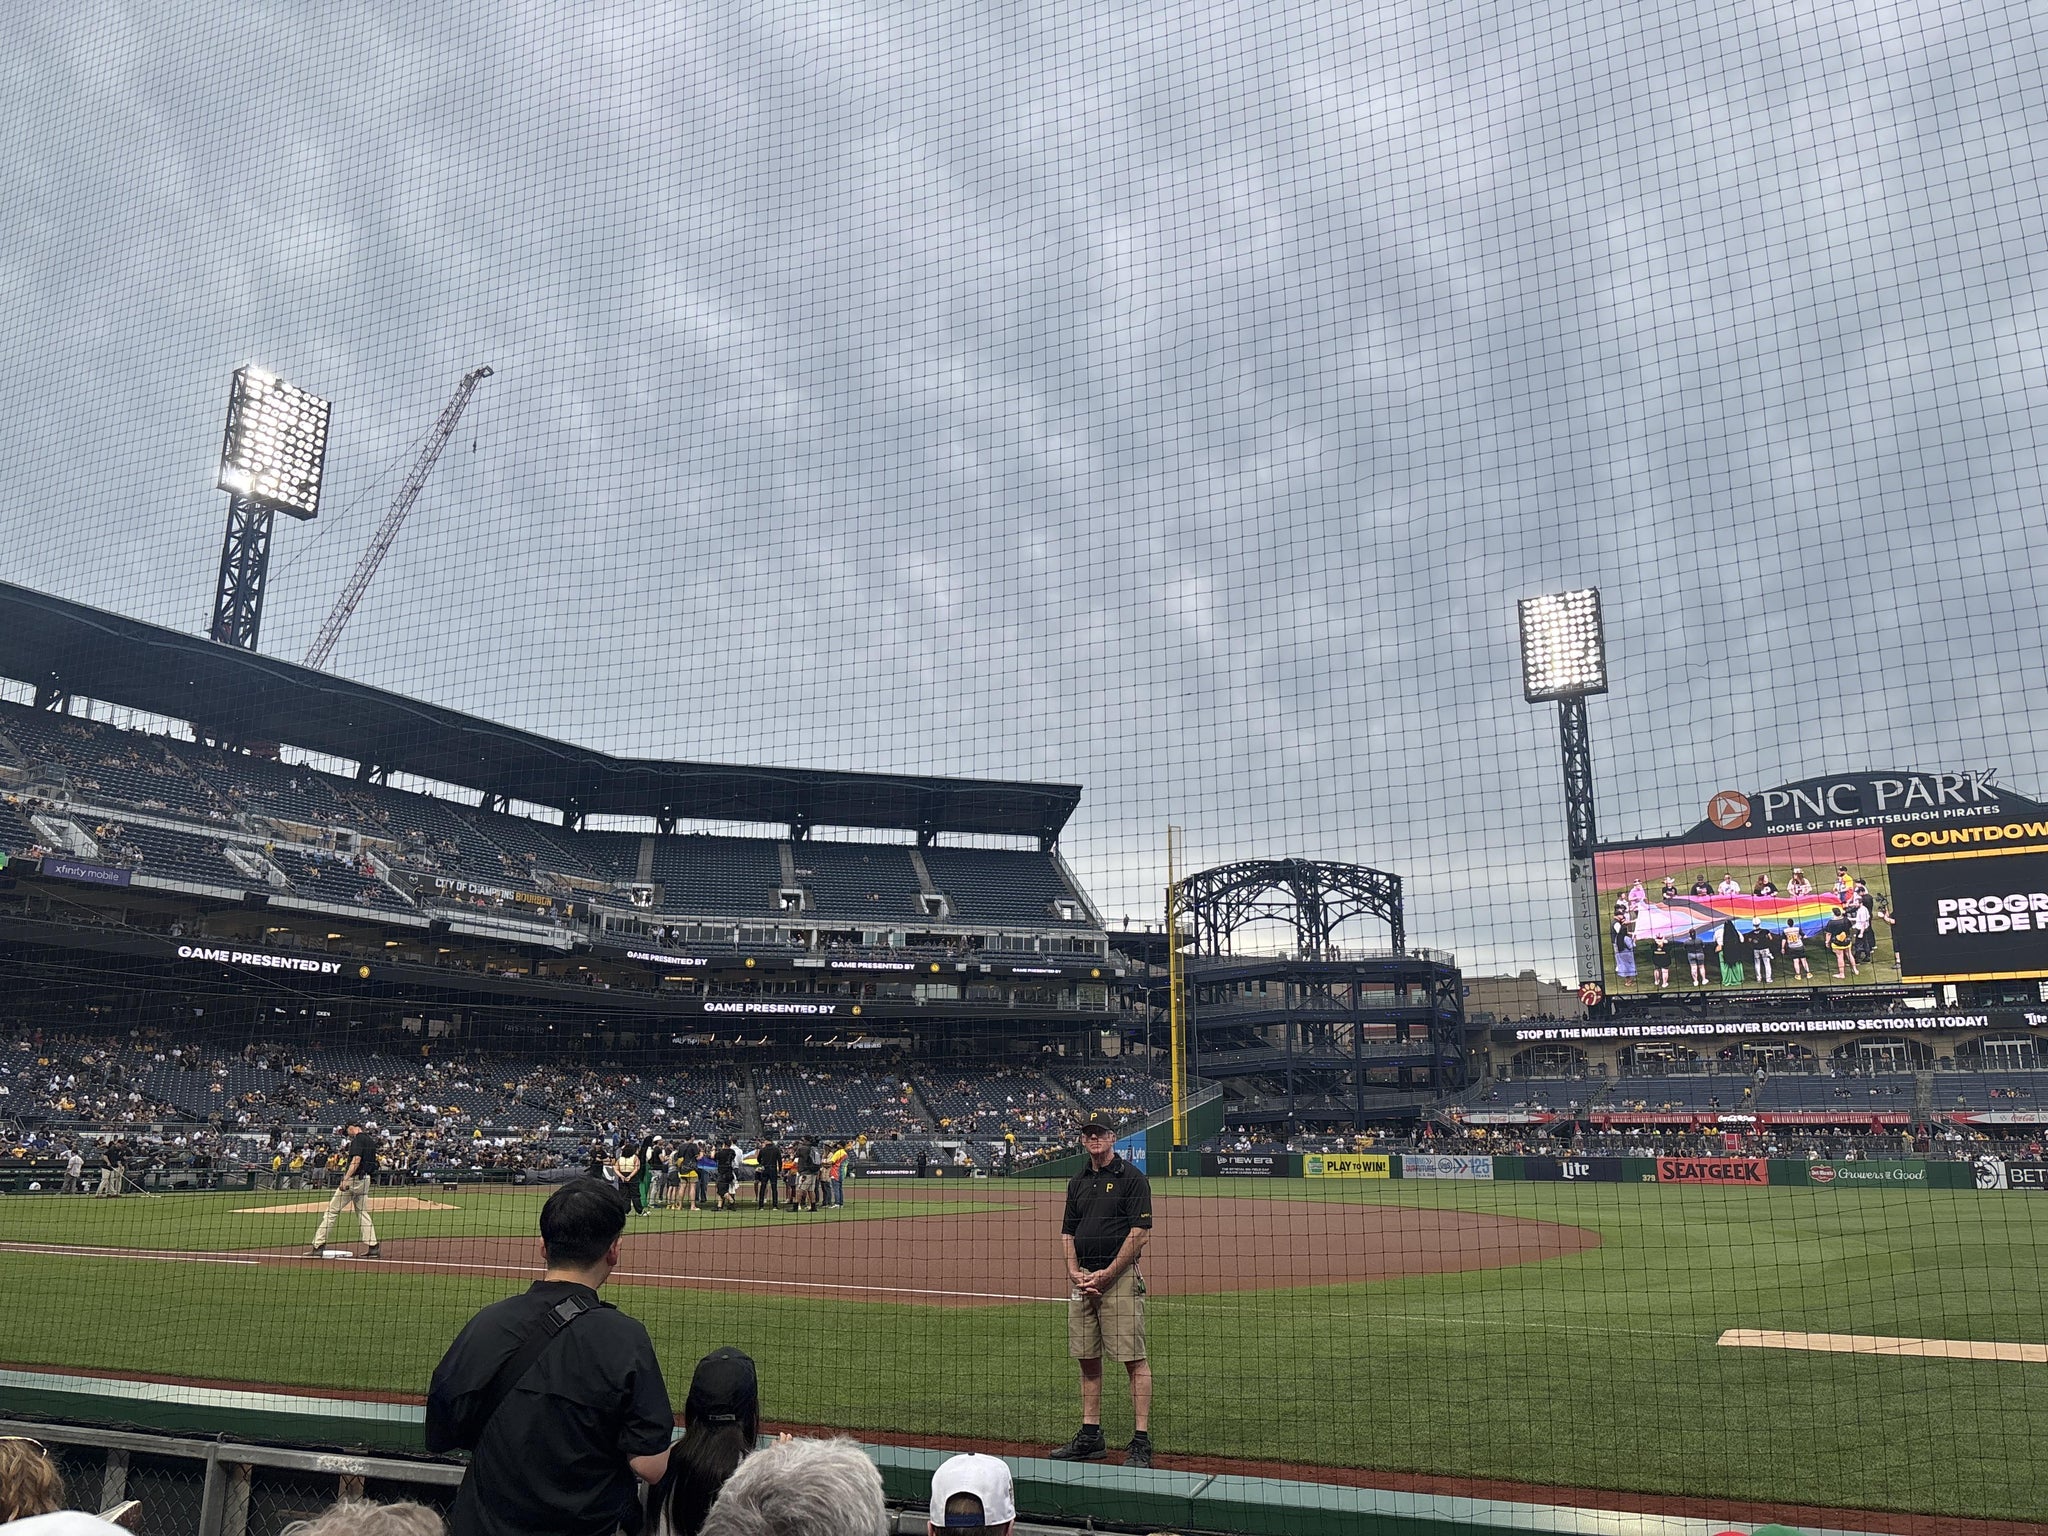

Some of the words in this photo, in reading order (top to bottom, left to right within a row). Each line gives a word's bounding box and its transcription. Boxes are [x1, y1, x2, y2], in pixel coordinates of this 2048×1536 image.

[1762, 784, 1859, 821] PNC
[1869, 768, 2000, 811] PARK
[1767, 822, 1803, 834] HOME
[1806, 820, 1825, 831] OF
[1827, 817, 1853, 828] THE
[1856, 809, 1940, 826] PITTSBURGH
[1943, 804, 2000, 818] PIRATES
[1891, 821, 2048, 849] COUNTDOW
[55, 864, 87, 877] xfinity
[88, 870, 119, 881] mobile
[435, 878, 455, 889] CITY
[456, 881, 467, 892] OF
[468, 883, 514, 900] CHAMPONS
[515, 891, 552, 906] BOURBON
[1937, 893, 2048, 916] PROGR
[1937, 912, 2031, 935] PRIDE
[178, 946, 230, 962] GAME
[231, 952, 320, 972] PRESENTED
[321, 962, 342, 974] BY
[627, 951, 650, 961] GAME
[650, 954, 694, 965] PRESENTED
[694, 958, 708, 966] BY
[857, 962, 903, 970] PRESENTED
[704, 1003, 744, 1013] GAME
[745, 1003, 818, 1014] PRESENTED
[818, 1005, 836, 1014] BY
[1516, 1030, 1544, 1040] STOP
[1545, 1029, 1559, 1039] BY
[1560, 1028, 1581, 1038] THE
[1582, 1027, 1618, 1038] MILLER
[1619, 1026, 1641, 1037] LITE
[1642, 1023, 1714, 1036] DESIGNATED
[1716, 1022, 1761, 1034] DRIVER
[1762, 1021, 1806, 1033] BOOTH
[1807, 1020, 1855, 1032] BEHIND
[1856, 1018, 1915, 1031] SECTION
[1916, 1017, 1936, 1028] 101
[1938, 1016, 1988, 1028] TODAY!
[1090, 1112, 1098, 1121] P
[1327, 1161, 1351, 1171] PLAY
[1362, 1161, 1386, 1172] WIN!
[1469, 1157, 1489, 1174] 125
[1562, 1161, 1590, 1179] Lite
[1662, 1161, 1762, 1182] SEATGEEK
[1838, 1167, 1884, 1179] Growers
[1893, 1168, 1925, 1180] Good
[1106, 1183, 1113, 1192] P
